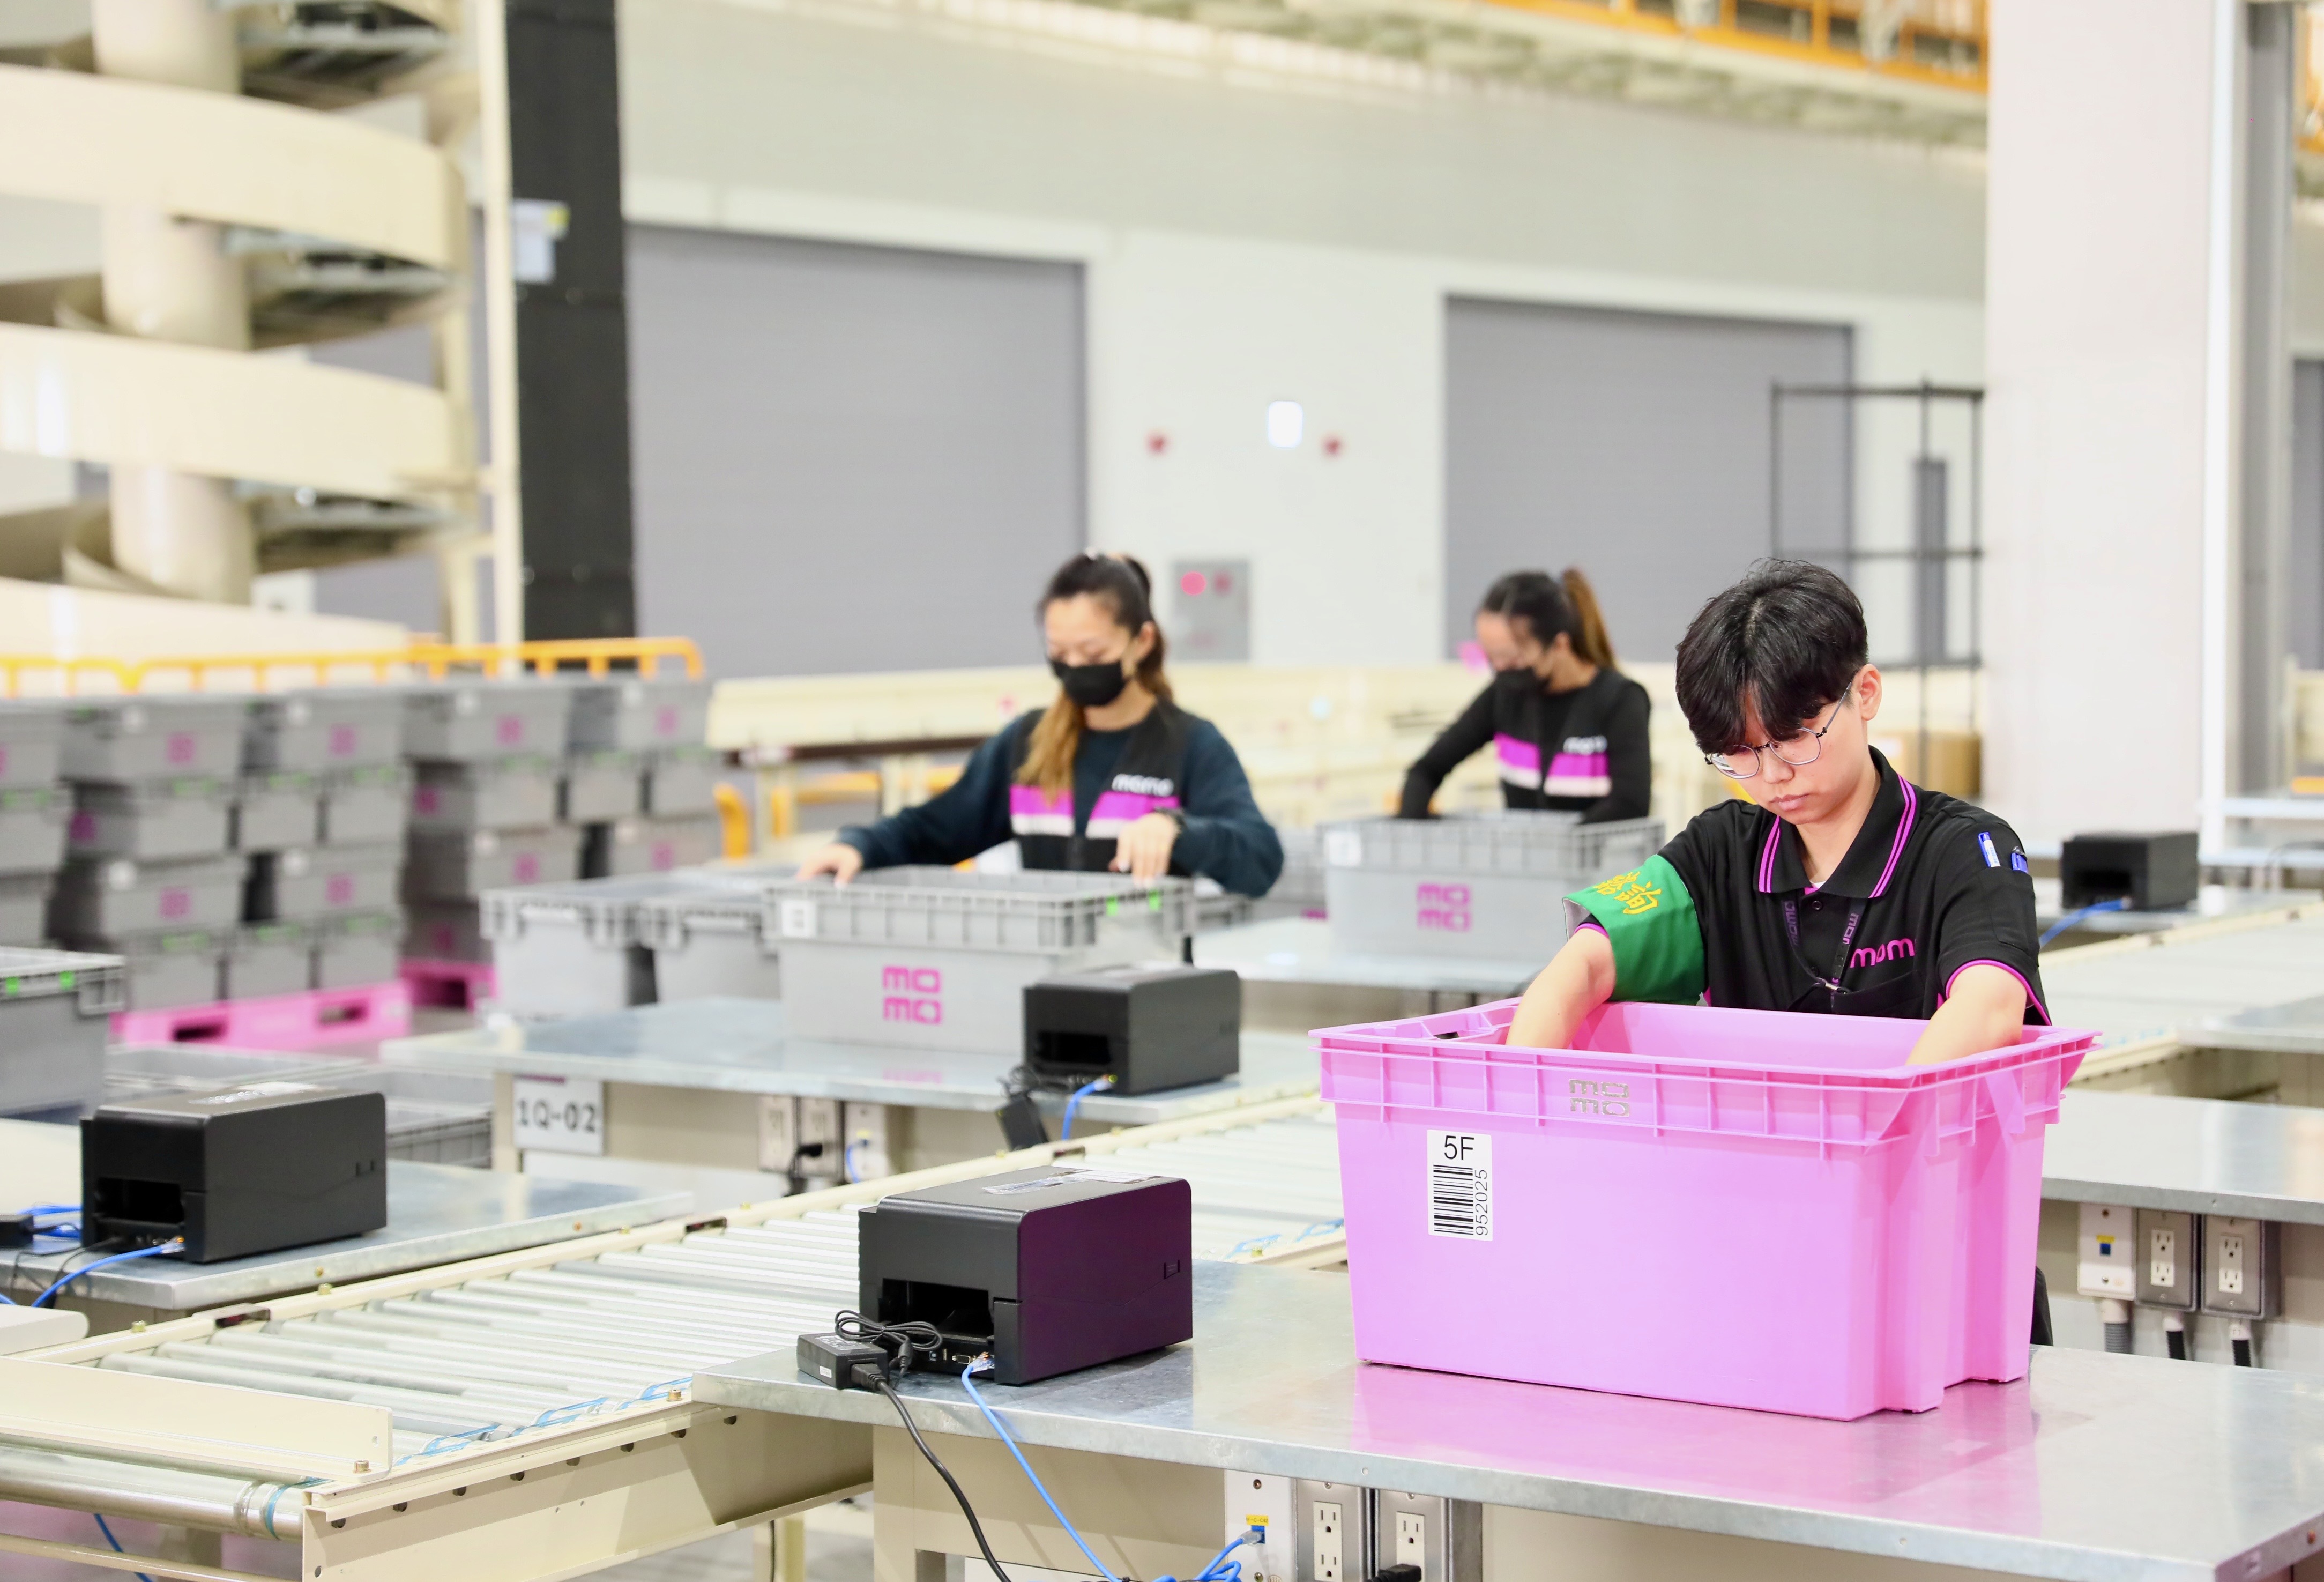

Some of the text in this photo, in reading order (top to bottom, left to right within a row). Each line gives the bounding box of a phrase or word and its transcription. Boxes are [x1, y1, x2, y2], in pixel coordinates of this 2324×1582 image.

[1850, 938, 1916, 968] mom
[517, 1099, 595, 1133] 1Q-02
[1444, 1135, 1474, 1161] 5F
[1474, 1169, 1488, 1236] 952025
